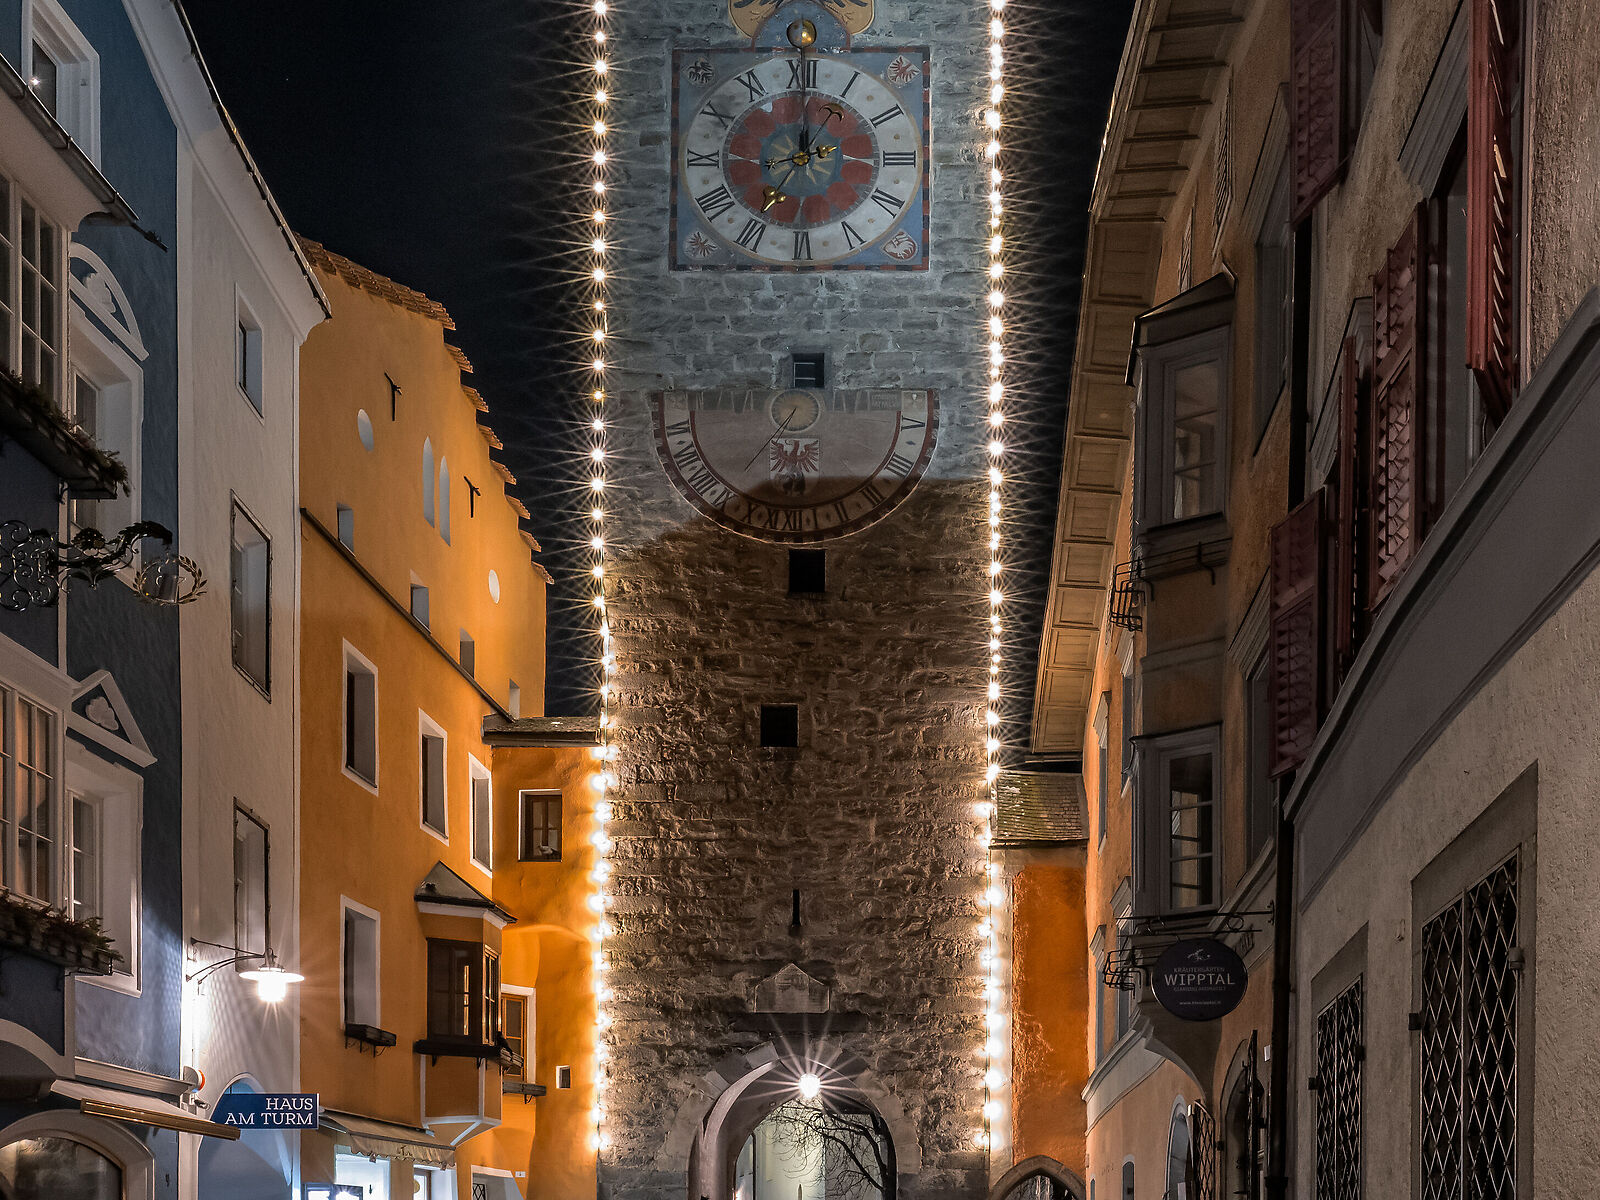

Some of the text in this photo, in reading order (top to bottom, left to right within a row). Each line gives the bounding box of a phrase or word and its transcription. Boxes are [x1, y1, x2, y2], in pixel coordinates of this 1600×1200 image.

[733, 68, 770, 103] XI
[786, 59, 819, 90] XII
[839, 70, 861, 99] I
[699, 100, 737, 131] X
[869, 103, 905, 129] II
[687, 149, 720, 169] IX
[882, 150, 917, 168] III
[694, 183, 736, 223] VIII
[870, 187, 906, 219] IV
[733, 218, 767, 253] VII
[792, 230, 814, 261] VI
[841, 220, 867, 251] V
[900, 415, 926, 432] V
[1164, 973, 1236, 986] WIPPTAL
[224, 1112, 313, 1125] AM TURM
[265, 1097, 313, 1110] HAUS
